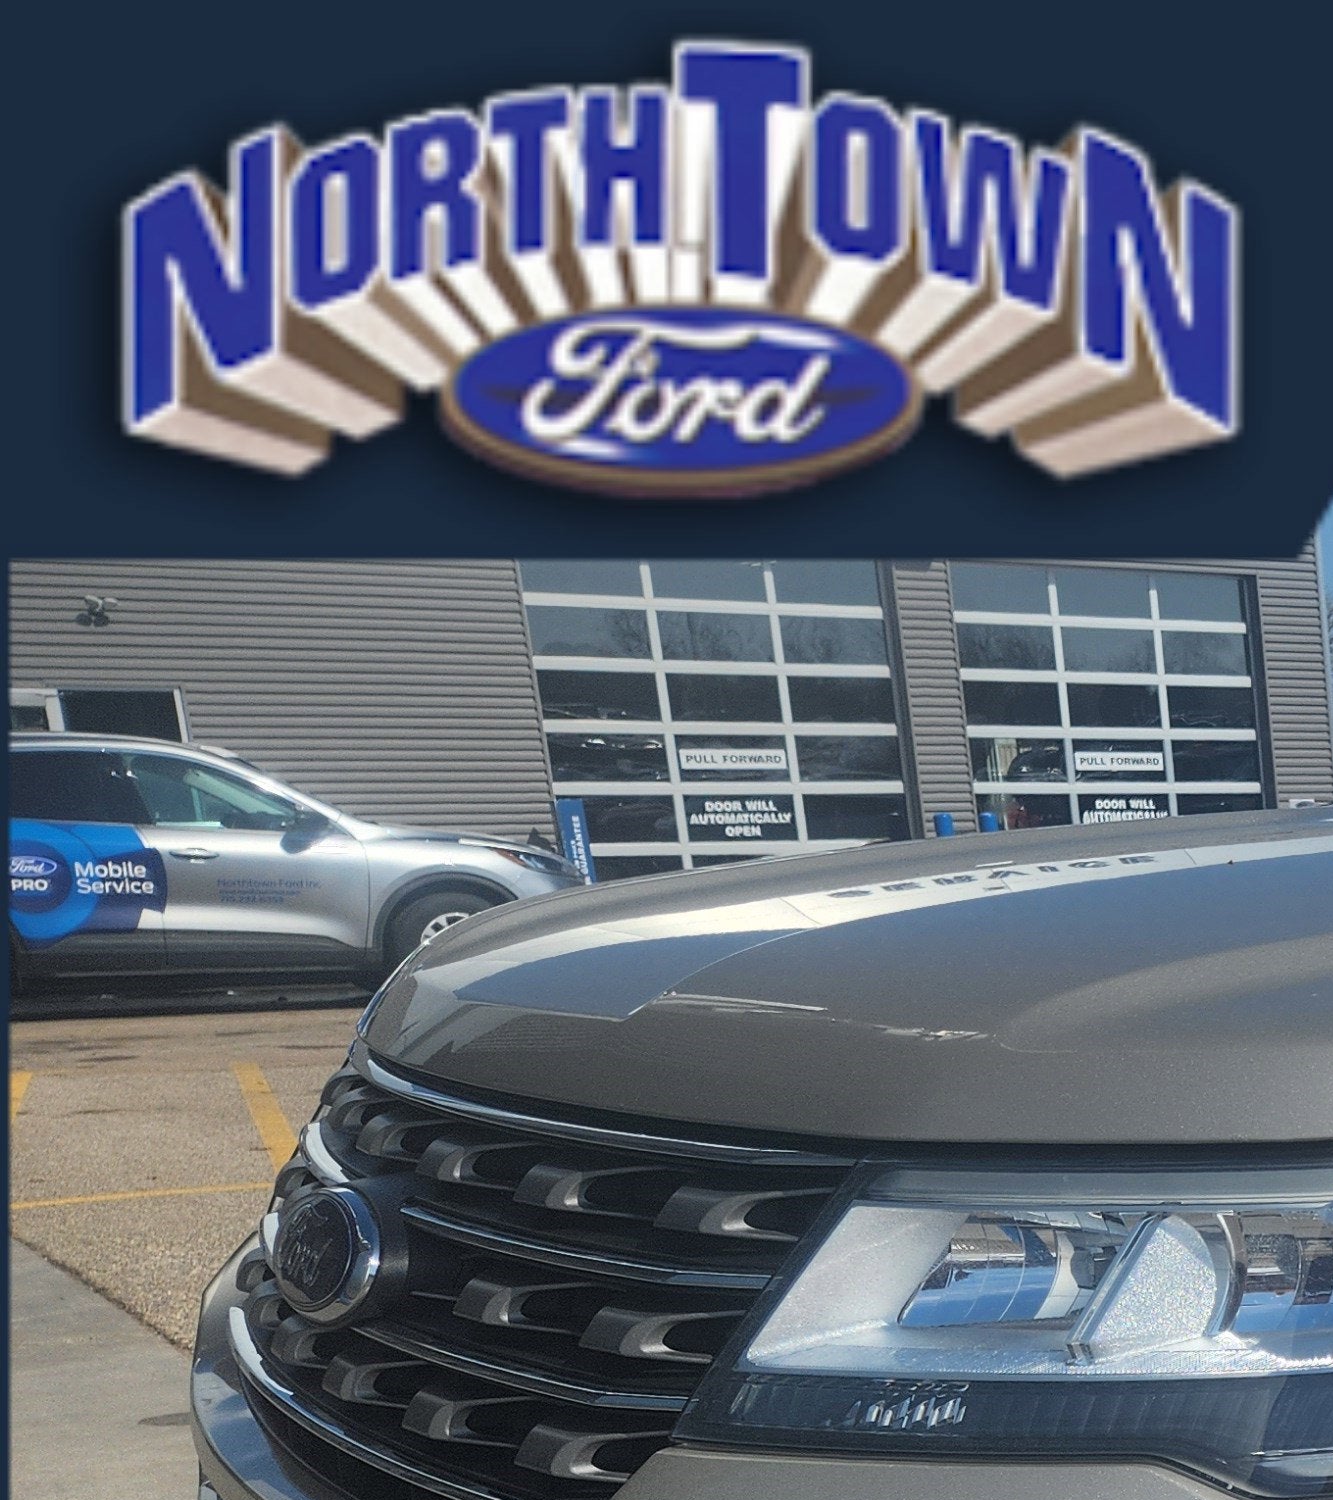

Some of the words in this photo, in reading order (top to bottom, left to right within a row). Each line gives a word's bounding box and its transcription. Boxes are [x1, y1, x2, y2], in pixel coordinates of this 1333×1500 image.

[685, 754, 718, 764] PULL
[722, 754, 782, 764] FORWARD
[1080, 757, 1107, 766] PULL
[1110, 757, 1160, 766] FORWARD
[704, 801, 743, 812] DOOR
[745, 800, 778, 812] WILL
[1095, 799, 1127, 810] DOOR
[1129, 799, 1156, 810] WILL
[690, 812, 792, 826] AUTOMATICALLY
[724, 825, 762, 837] OPEN
[74, 861, 147, 878] Mobile
[11, 878, 49, 892] PRO
[76, 878, 155, 895] Service
